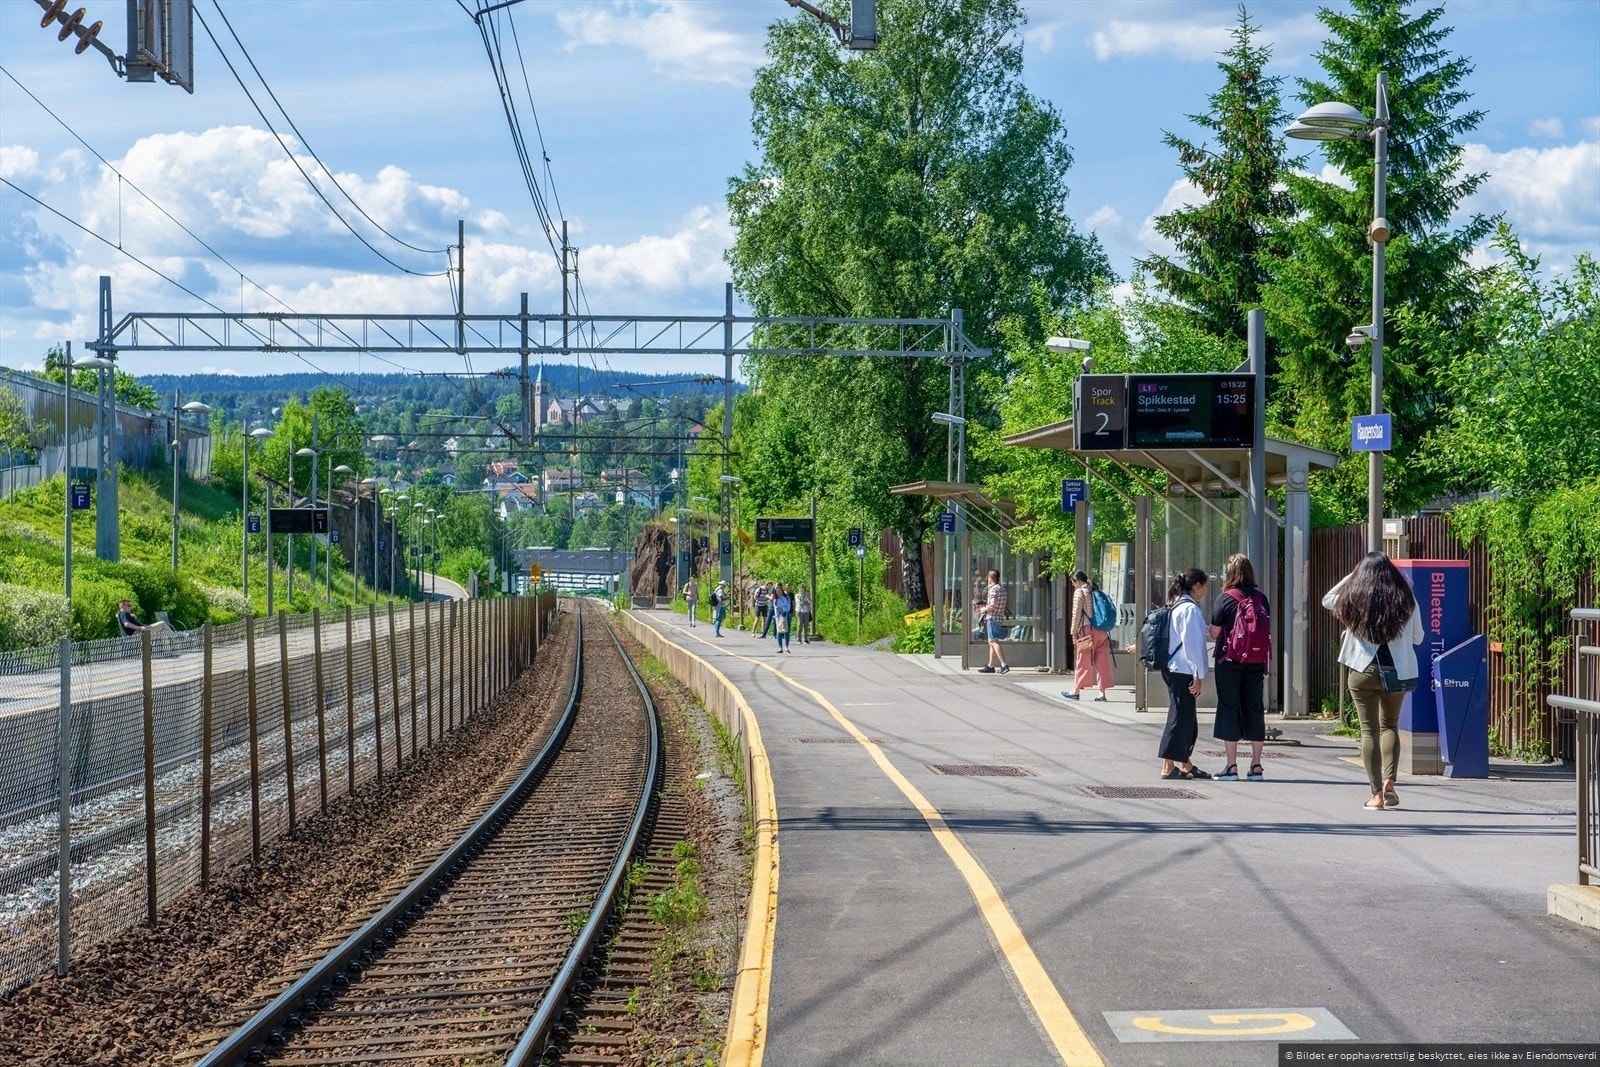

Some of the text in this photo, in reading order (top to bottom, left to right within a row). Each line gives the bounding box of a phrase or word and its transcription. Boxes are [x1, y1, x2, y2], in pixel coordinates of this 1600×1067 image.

[1091, 387, 1112, 398] Spor
[1091, 396, 1115, 406] Track
[1138, 395, 1196, 406] Spikkestad
[1217, 394, 1246, 404] 15:25
[1094, 412, 1110, 435] 2
[78, 495, 84, 506] F
[1070, 493, 1078, 507] F
[251, 522, 257, 530] E
[943, 523, 950, 533] E
[760, 530, 766, 538] 2
[1431, 572, 1445, 635] Billetter
[1444, 678, 1469, 688] ENTUR
